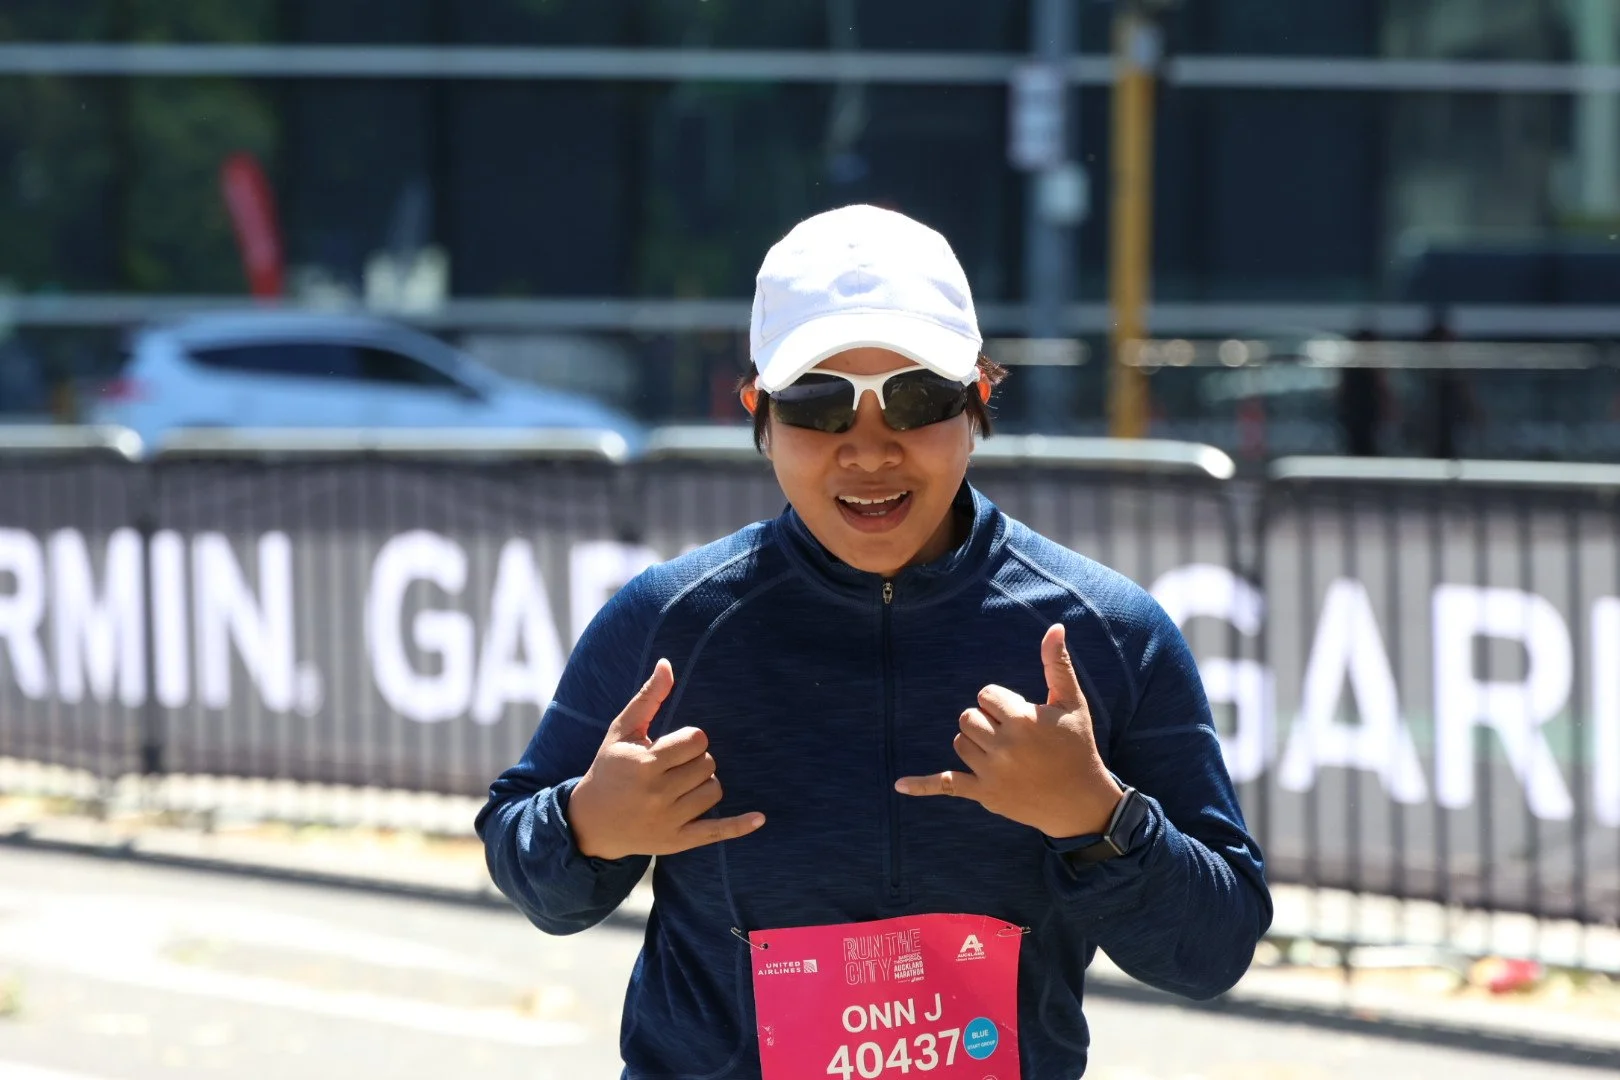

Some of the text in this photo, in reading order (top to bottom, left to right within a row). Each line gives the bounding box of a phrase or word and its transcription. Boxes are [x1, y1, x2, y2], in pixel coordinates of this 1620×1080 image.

[843, 928, 922, 962] RUN THE
[758, 967, 801, 976] AIRLINES
[765, 961, 801, 969] UNITED
[845, 957, 892, 986] CITY
[894, 967, 925, 980] MARATHON
[842, 992, 942, 1033] ONN J
[971, 1029, 990, 1040] BLUE
[826, 1027, 961, 1080] 40437
